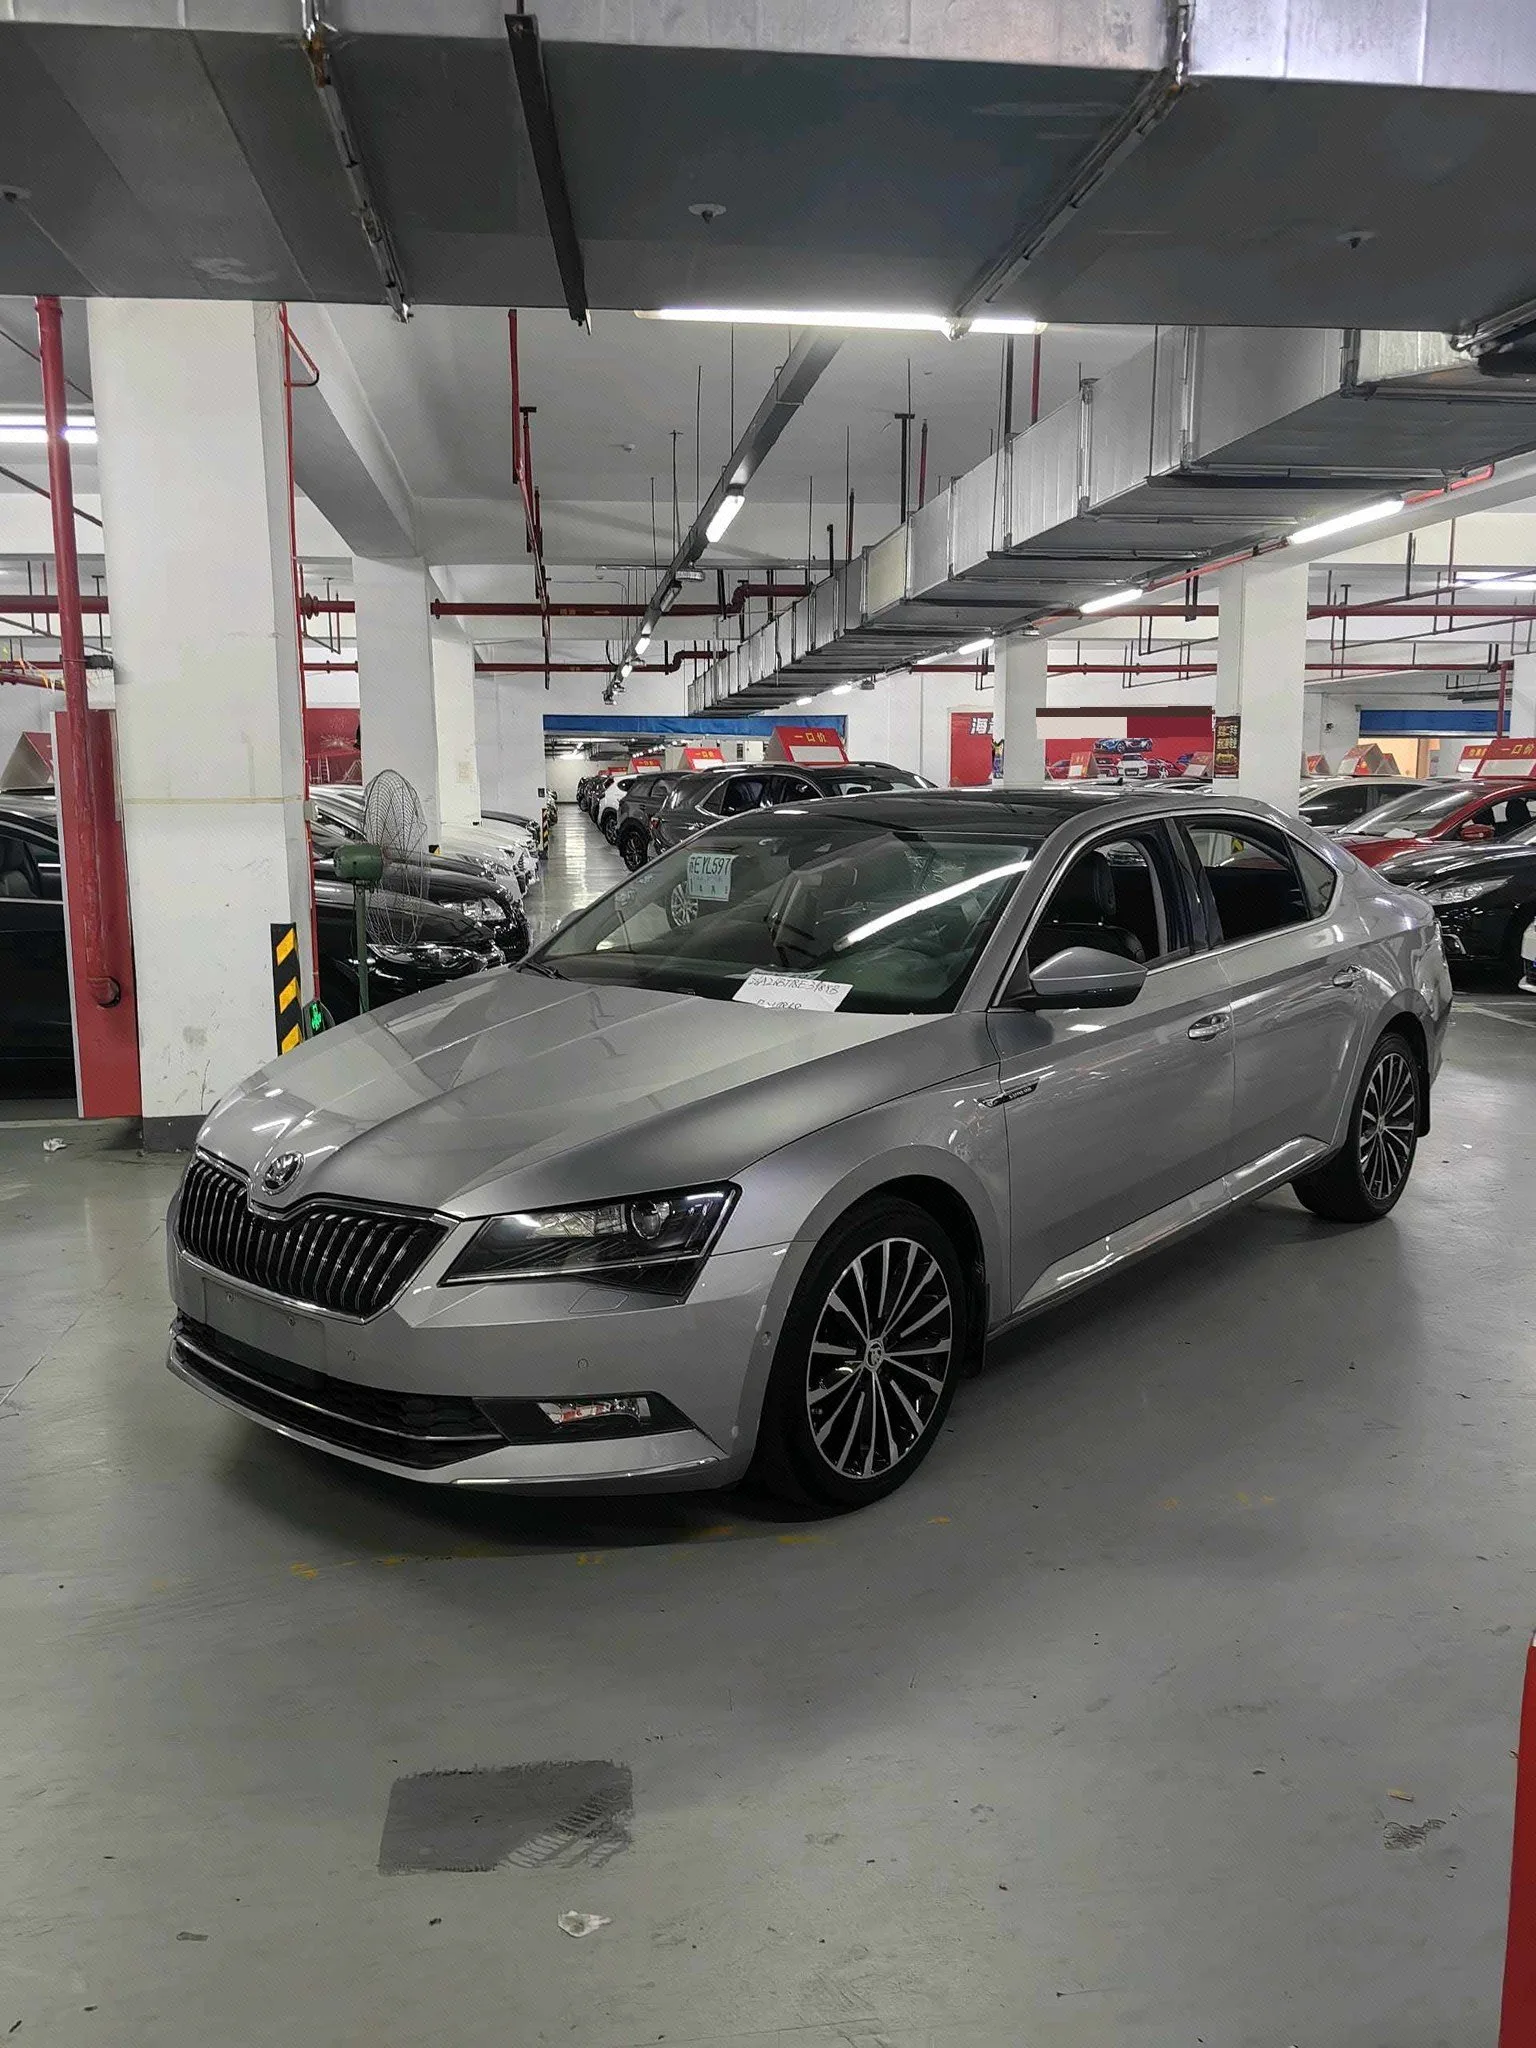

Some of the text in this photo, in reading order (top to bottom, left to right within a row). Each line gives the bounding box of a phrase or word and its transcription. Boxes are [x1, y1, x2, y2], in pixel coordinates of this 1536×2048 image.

[794, 731, 827, 743] 一口价
[1500, 744, 1535, 755] 一口价
